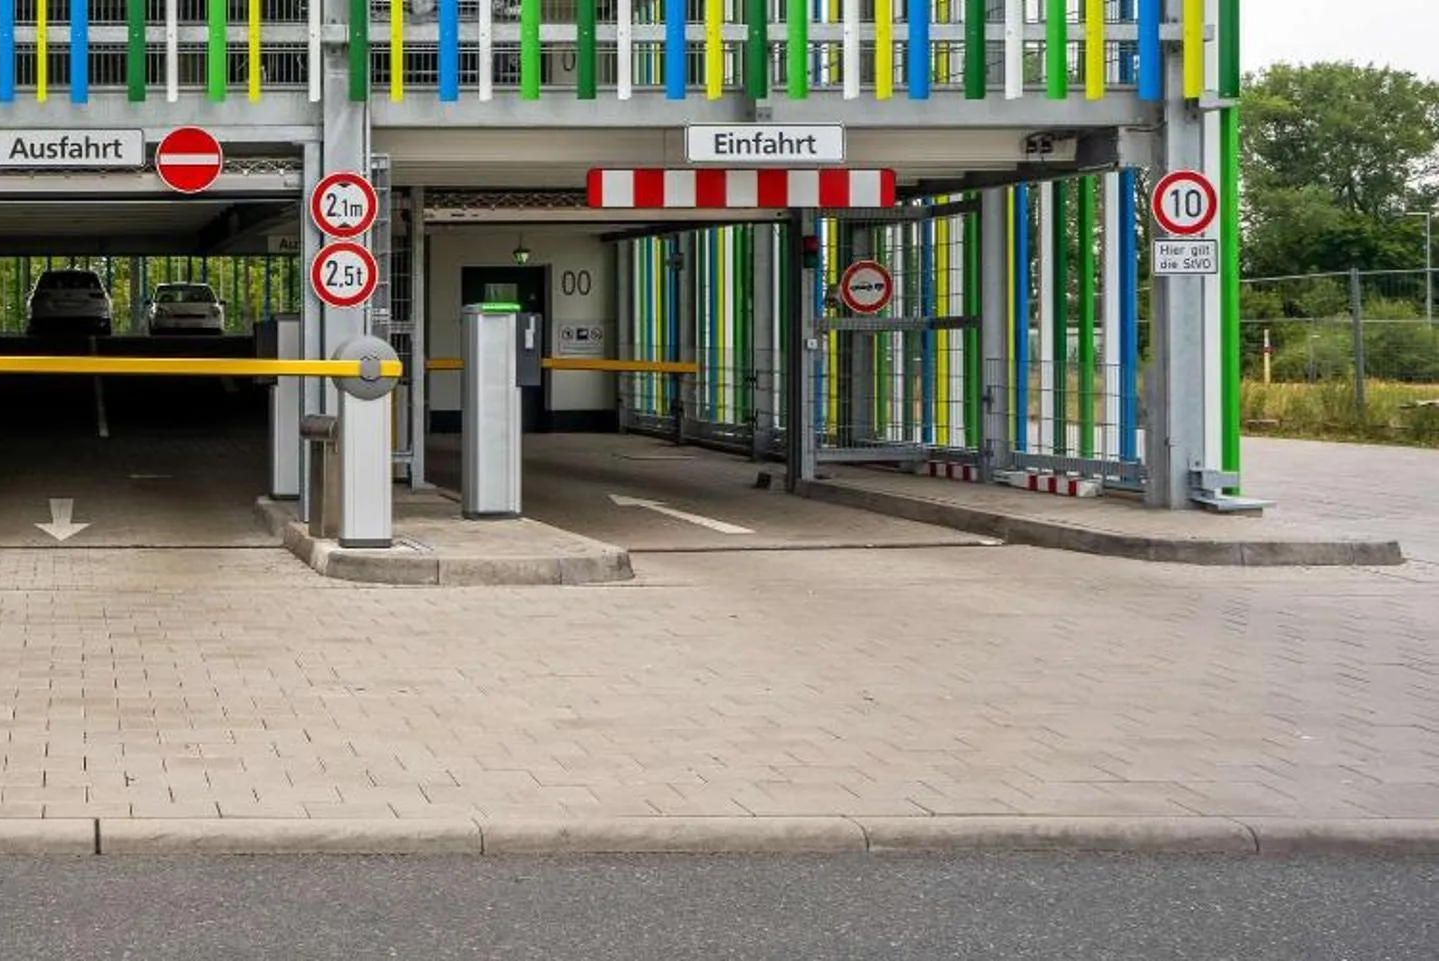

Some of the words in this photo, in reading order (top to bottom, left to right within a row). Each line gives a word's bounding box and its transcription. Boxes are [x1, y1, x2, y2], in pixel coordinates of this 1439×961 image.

[9, 136, 123, 159] Ausfahrt
[714, 131, 817, 154] Einfahrt
[1170, 189, 1202, 218] 10
[1160, 245, 1186, 255] Hier
[1190, 245, 1210, 256] gilt
[1160, 260, 1179, 269] die
[1183, 259, 1211, 269] StVO
